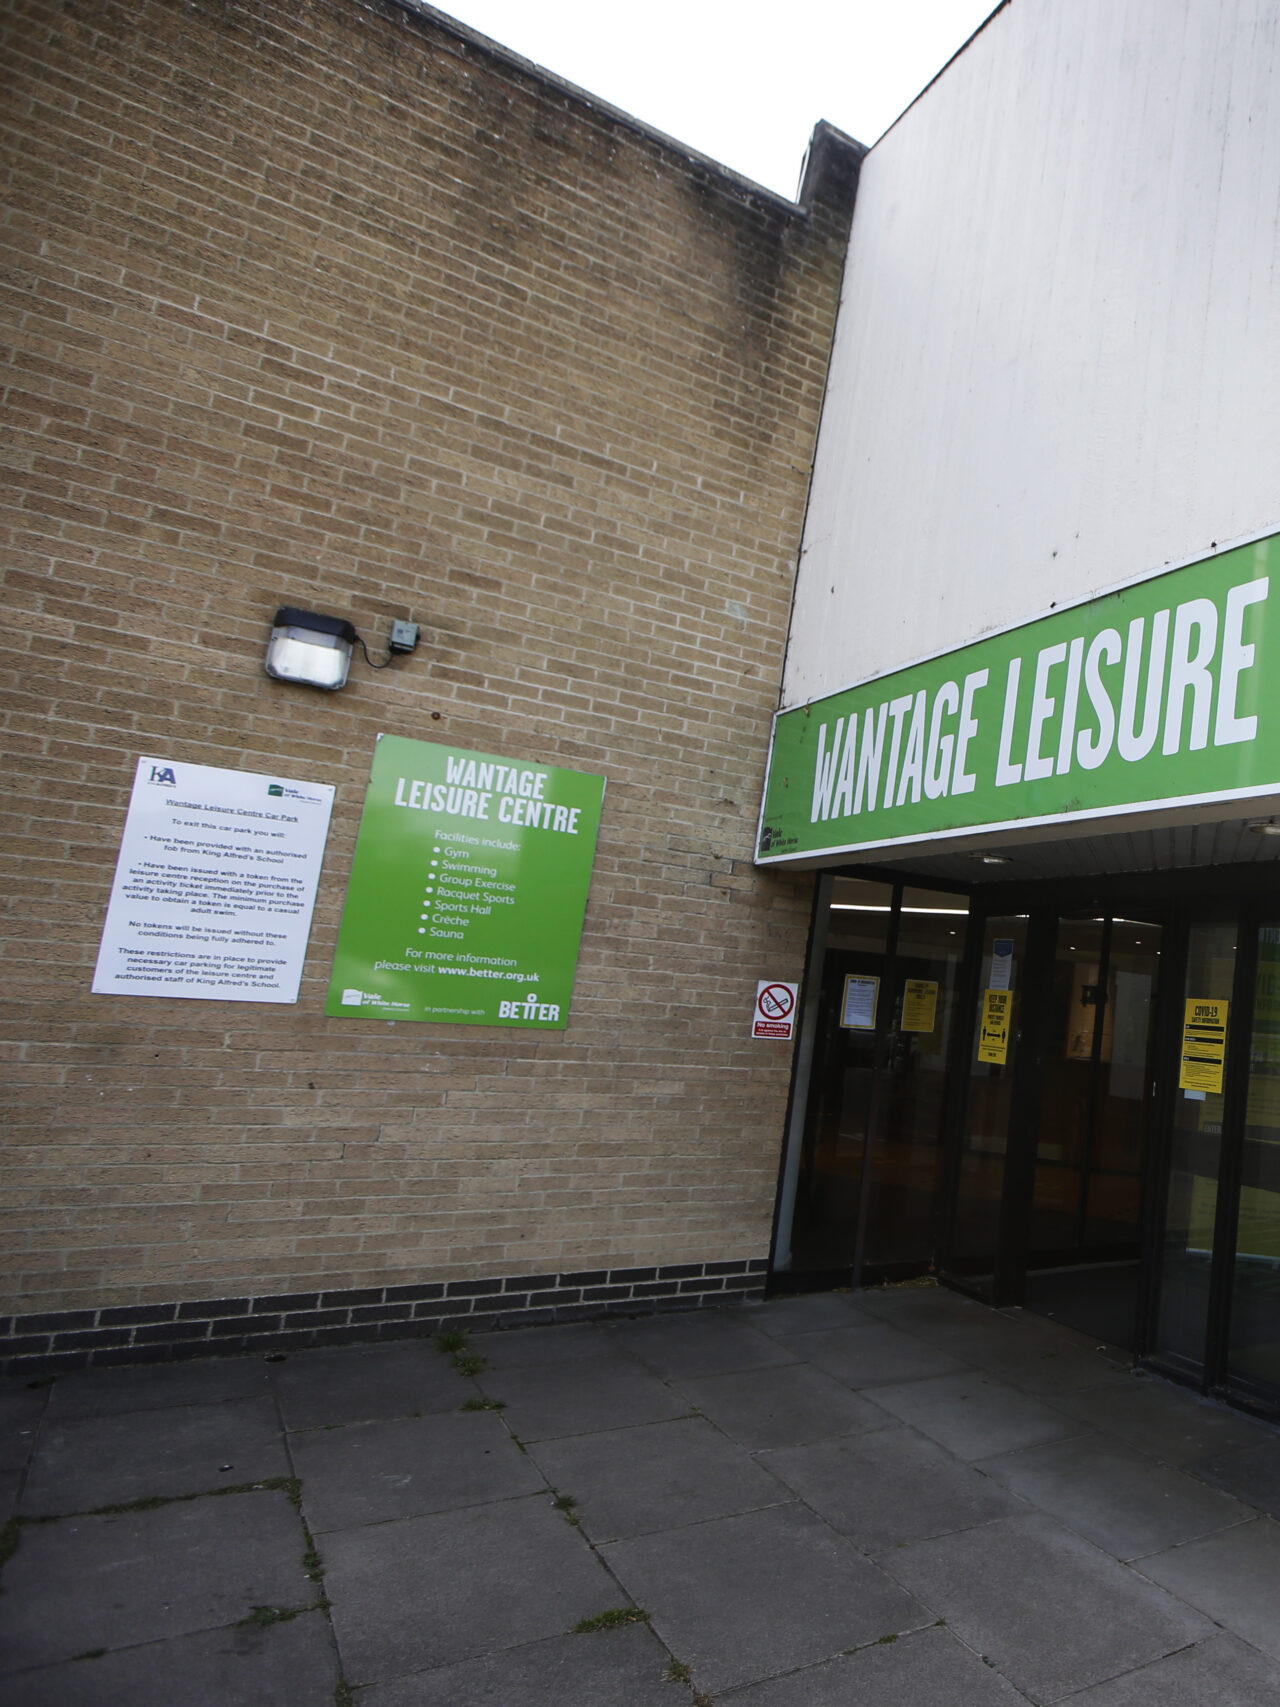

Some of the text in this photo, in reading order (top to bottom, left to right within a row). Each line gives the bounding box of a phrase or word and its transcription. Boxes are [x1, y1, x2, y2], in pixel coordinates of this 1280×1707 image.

[810, 667, 990, 824] WANTAGE
[995, 576, 1270, 788] LEISURE
[446, 756, 547, 799] WANTAGE
[165, 798, 202, 809] Wantage
[203, 804, 235, 813] Leisure
[236, 808, 263, 817] Centre
[280, 814, 298, 822] Park
[394, 777, 581, 834] LEISURE CENTRE
[200, 822, 217, 830] this
[149, 834, 172, 843] Have
[173, 837, 194, 845] been
[196, 841, 233, 850] provided
[265, 849, 307, 859] authorised
[434, 829, 520, 851] Facilities include:
[163, 844, 178, 852] fob
[180, 846, 200, 854] from
[201, 849, 221, 858] King
[255, 855, 284, 864] School
[444, 846, 469, 859] Gym
[143, 861, 165, 869] Have
[167, 864, 188, 872] been
[190, 867, 218, 875] issued
[441, 859, 497, 877] Swimming
[128, 868, 159, 876] leisure
[160, 872, 188, 880] centre
[190, 875, 229, 884] reception
[258, 883, 294, 891] purchase
[145, 879, 177, 888] activity
[179, 881, 203, 889] ticket
[204, 885, 253, 895] immediately
[439, 872, 516, 891] Group Exercise
[121, 884, 154, 893] activity
[156, 887, 183, 896] taking
[212, 892, 227, 900] The
[229, 895, 267, 903] minimum
[268, 899, 305, 907] purchase
[161, 896, 189, 904] obtain
[436, 886, 515, 904] Racquet Sports
[434, 899, 491, 914] Sports Hall
[143, 922, 172, 930] tokens
[431, 913, 469, 926] Crèche
[137, 930, 183, 939] conditions
[185, 933, 209, 942] being
[211, 935, 229, 943] fully
[230, 937, 264, 945] adhered
[429, 926, 464, 939] Sauna
[117, 946, 145, 955] These
[146, 950, 196, 959] restrictions
[404, 946, 517, 966] For more information
[126, 957, 172, 966] necessary
[189, 962, 221, 970] parking
[236, 964, 276, 972] legitimate
[373, 959, 540, 983] please visit www.better.org.uk
[114, 973, 162, 981] authorised
[196, 977, 216, 986] King
[498, 1000, 560, 1021] BETTER
[1194, 1005, 1218, 1017] COVID-19
